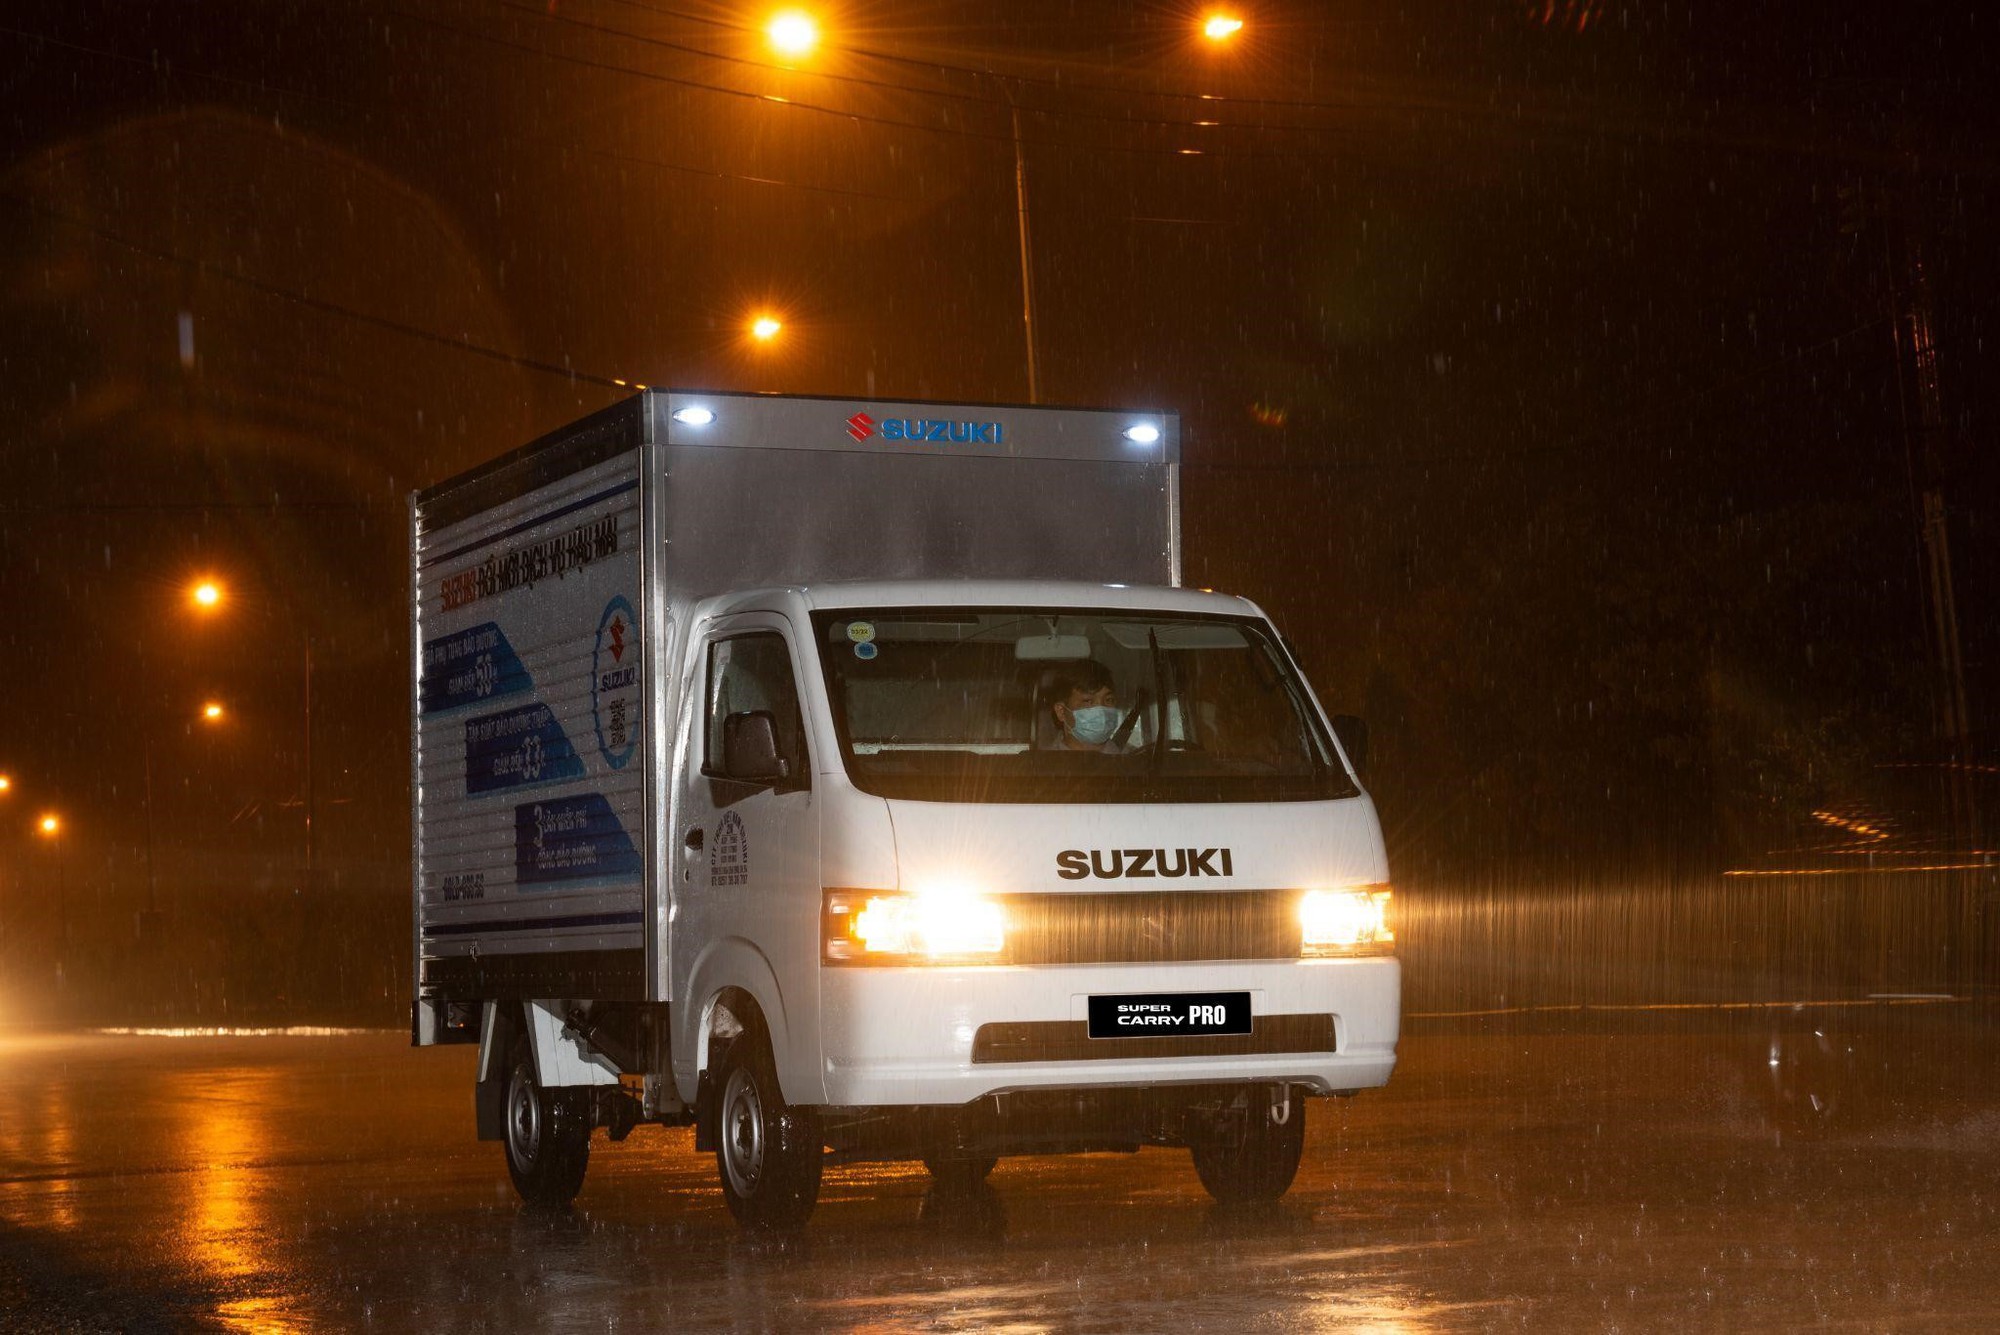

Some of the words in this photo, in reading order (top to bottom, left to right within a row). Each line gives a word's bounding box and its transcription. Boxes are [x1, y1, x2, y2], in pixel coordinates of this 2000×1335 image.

[881, 418, 1003, 444] SUZUKI
[441, 567, 476, 613] SUZUKI
[601, 668, 635, 692] SUZUKI
[1056, 848, 1233, 880] SUZUKI
[1117, 1016, 1185, 1025] CARRY
[1189, 1005, 1226, 1025] PRO
